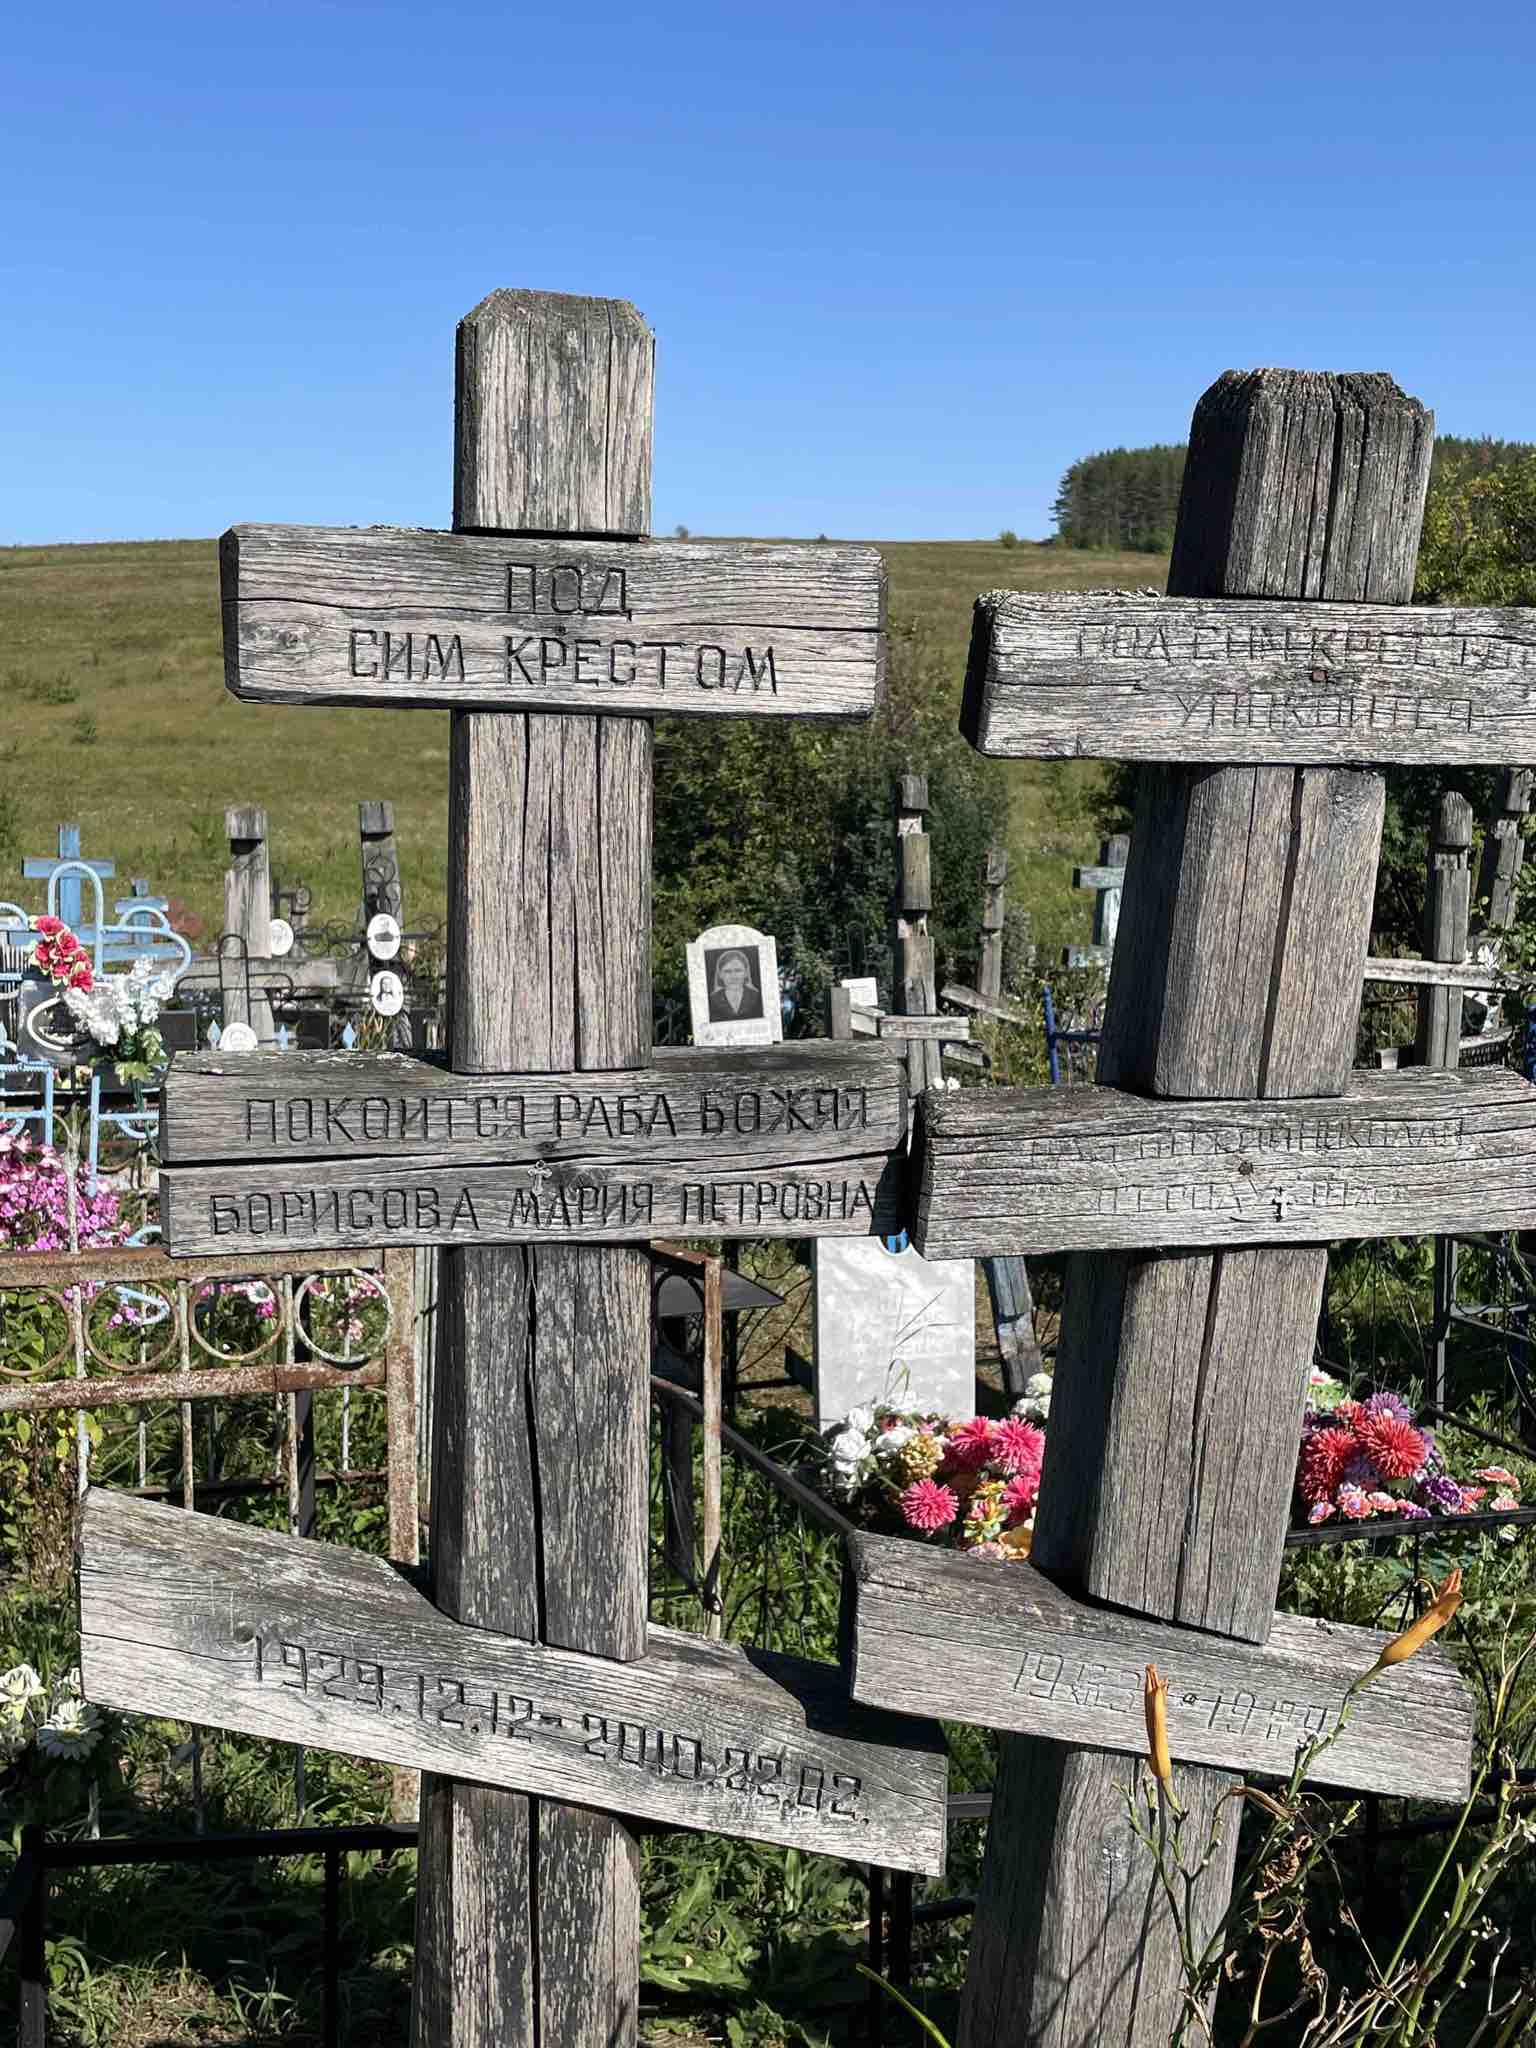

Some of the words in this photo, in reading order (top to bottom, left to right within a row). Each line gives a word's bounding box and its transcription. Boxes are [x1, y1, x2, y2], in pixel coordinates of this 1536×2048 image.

[505, 561, 633, 620] ПОД
[348, 629, 466, 683] СИМ
[503, 634, 778, 696] КРЕСТОМ
[246, 1097, 527, 1143] ПОКОИТСЯ
[555, 1092, 678, 1138] РАБА
[211, 1186, 480, 1237] БОРИСОВА
[508, 1182, 654, 1229] МАРИЯ
[680, 1178, 878, 1224] ПЕТРОВНА
